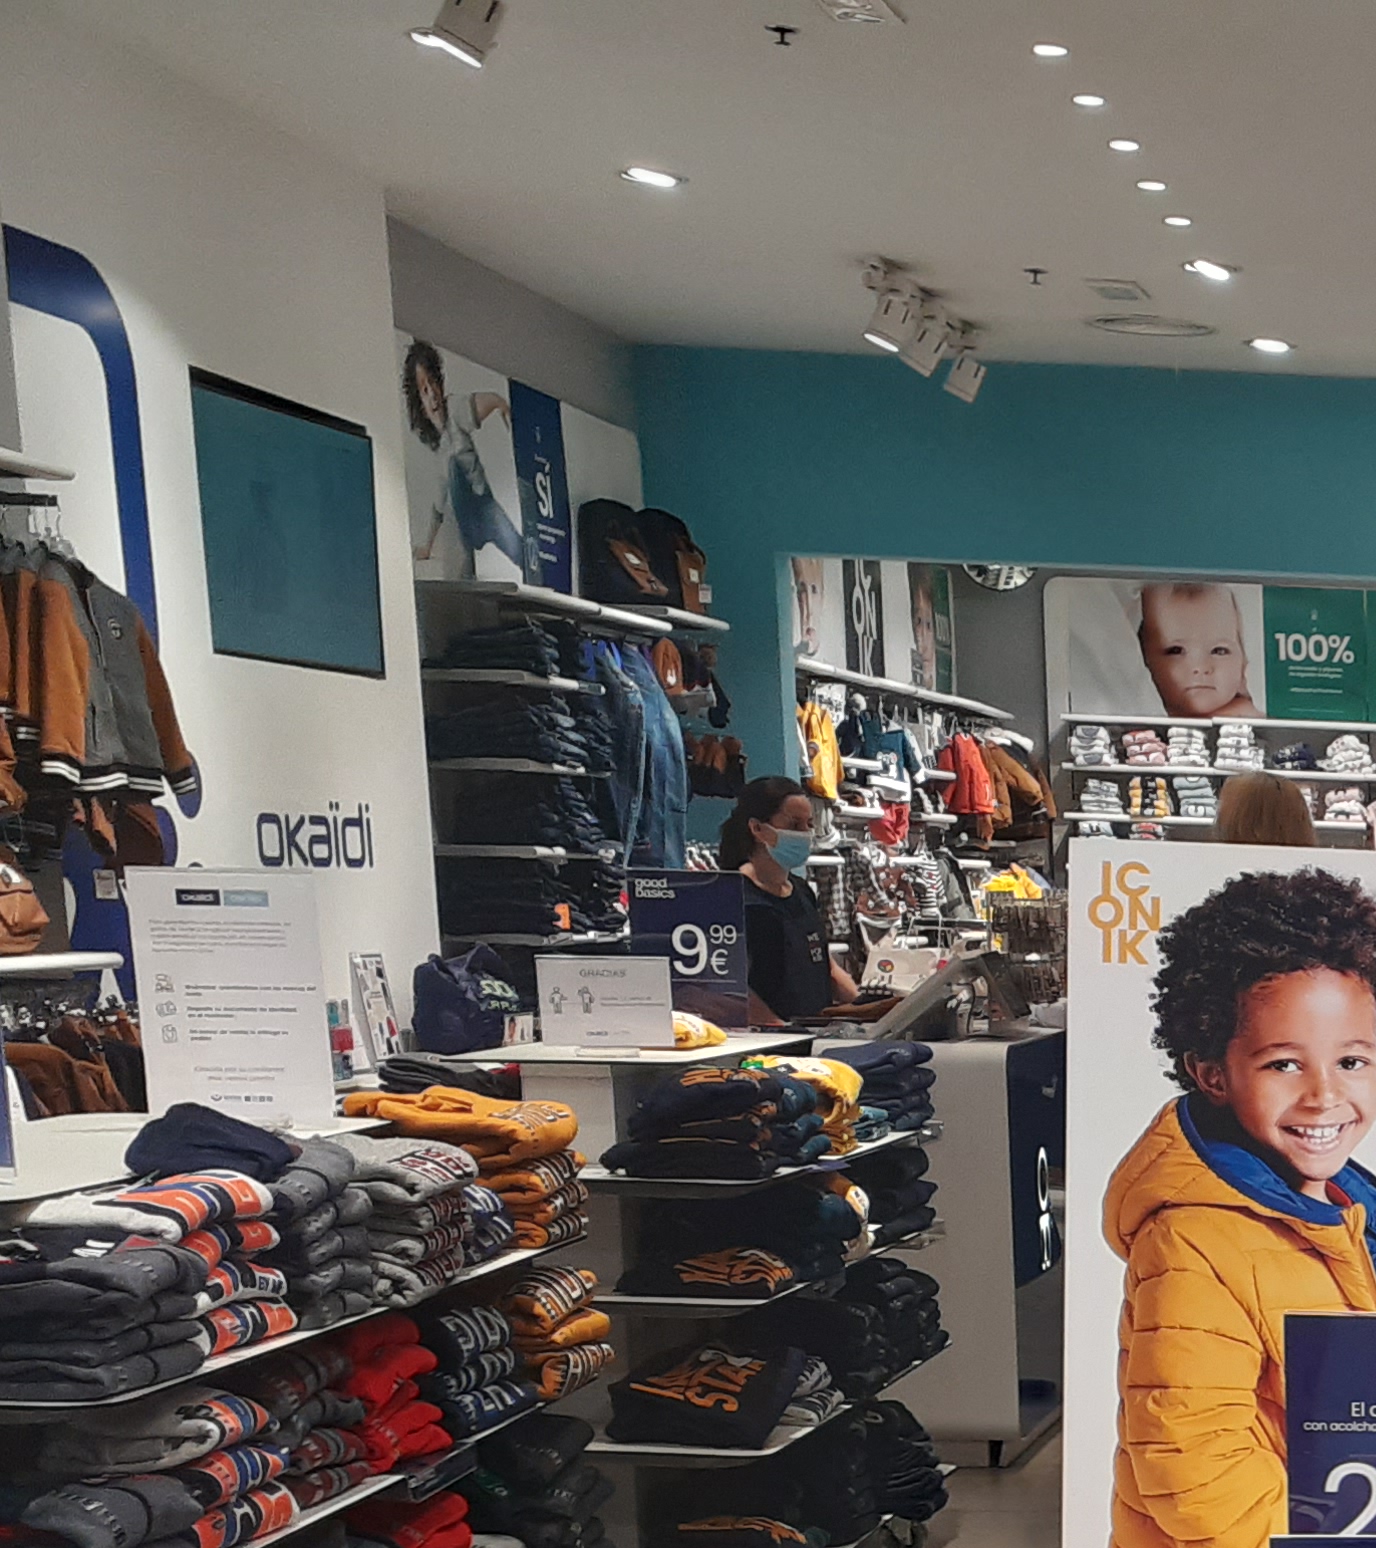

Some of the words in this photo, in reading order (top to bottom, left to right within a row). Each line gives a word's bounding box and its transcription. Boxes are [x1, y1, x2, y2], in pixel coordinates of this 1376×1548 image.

[1274, 632, 1355, 665] 100%
[634, 878, 668, 891] good
[634, 888, 676, 899] basics
[672, 924, 708, 976] 9
[709, 924, 737, 945] 99
[1350, 1401, 1366, 1418] El
[1303, 1421, 1328, 1431] con
